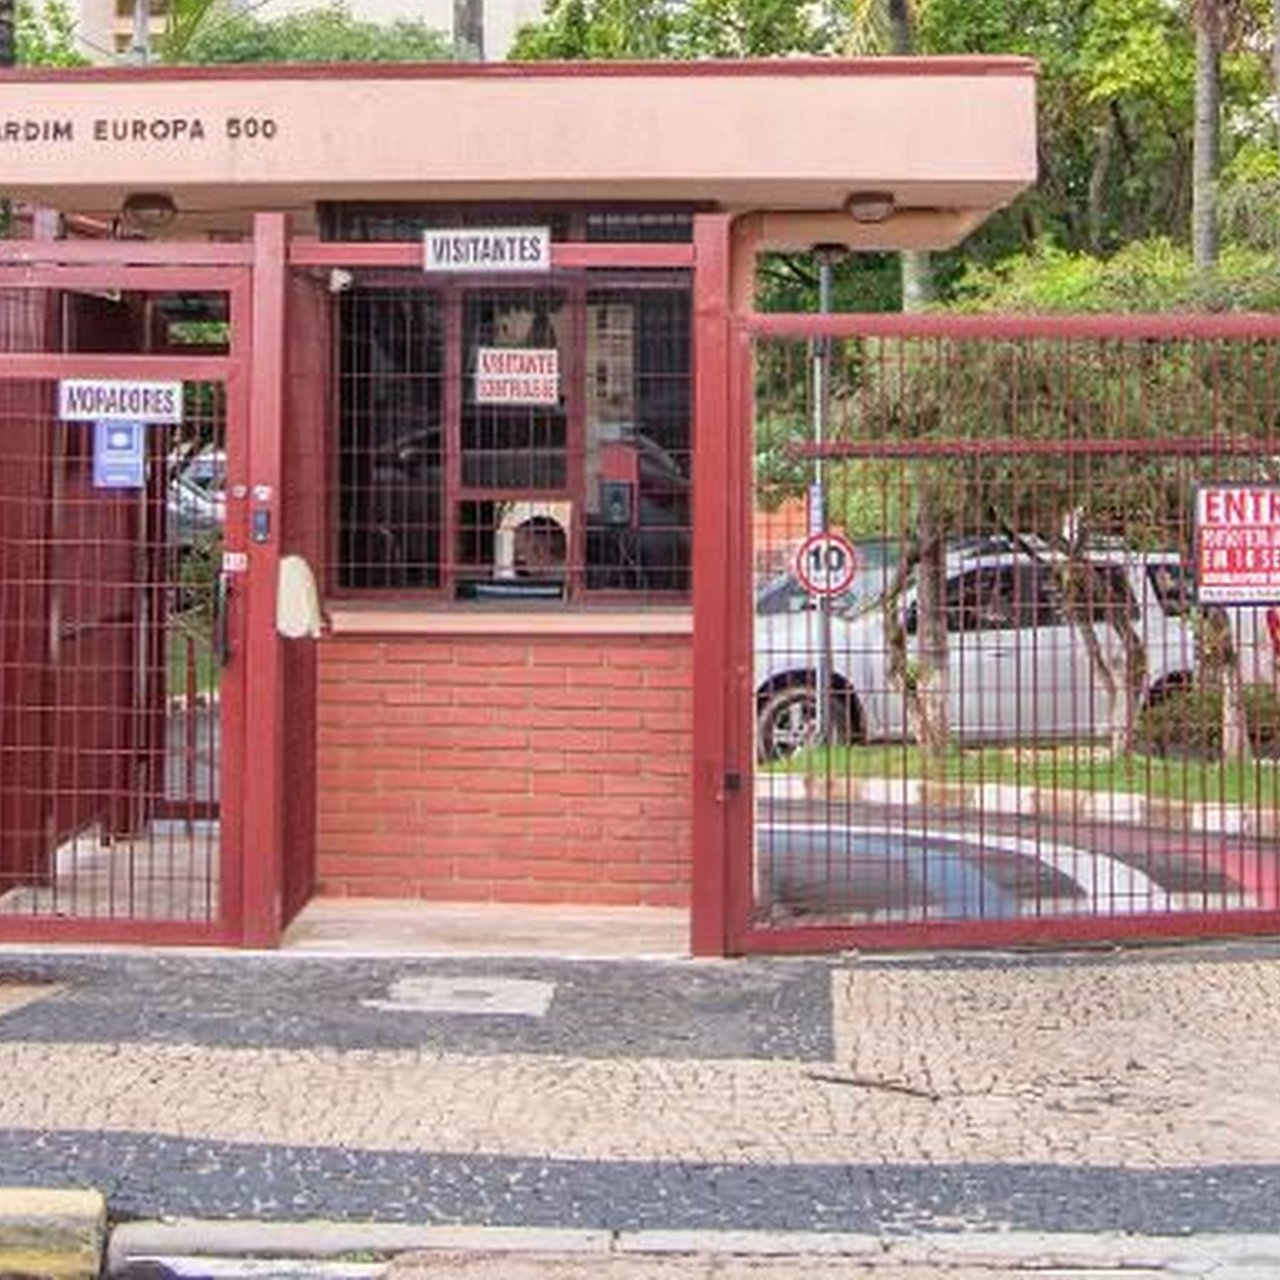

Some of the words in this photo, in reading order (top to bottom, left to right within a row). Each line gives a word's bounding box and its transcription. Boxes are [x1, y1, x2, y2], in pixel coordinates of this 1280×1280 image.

[93, 118, 205, 141] EUROPA
[226, 117, 278, 140] 500
[432, 236, 542, 263] VISITANTES
[67, 386, 174, 414] MORADORES
[808, 545, 846, 572] 10
